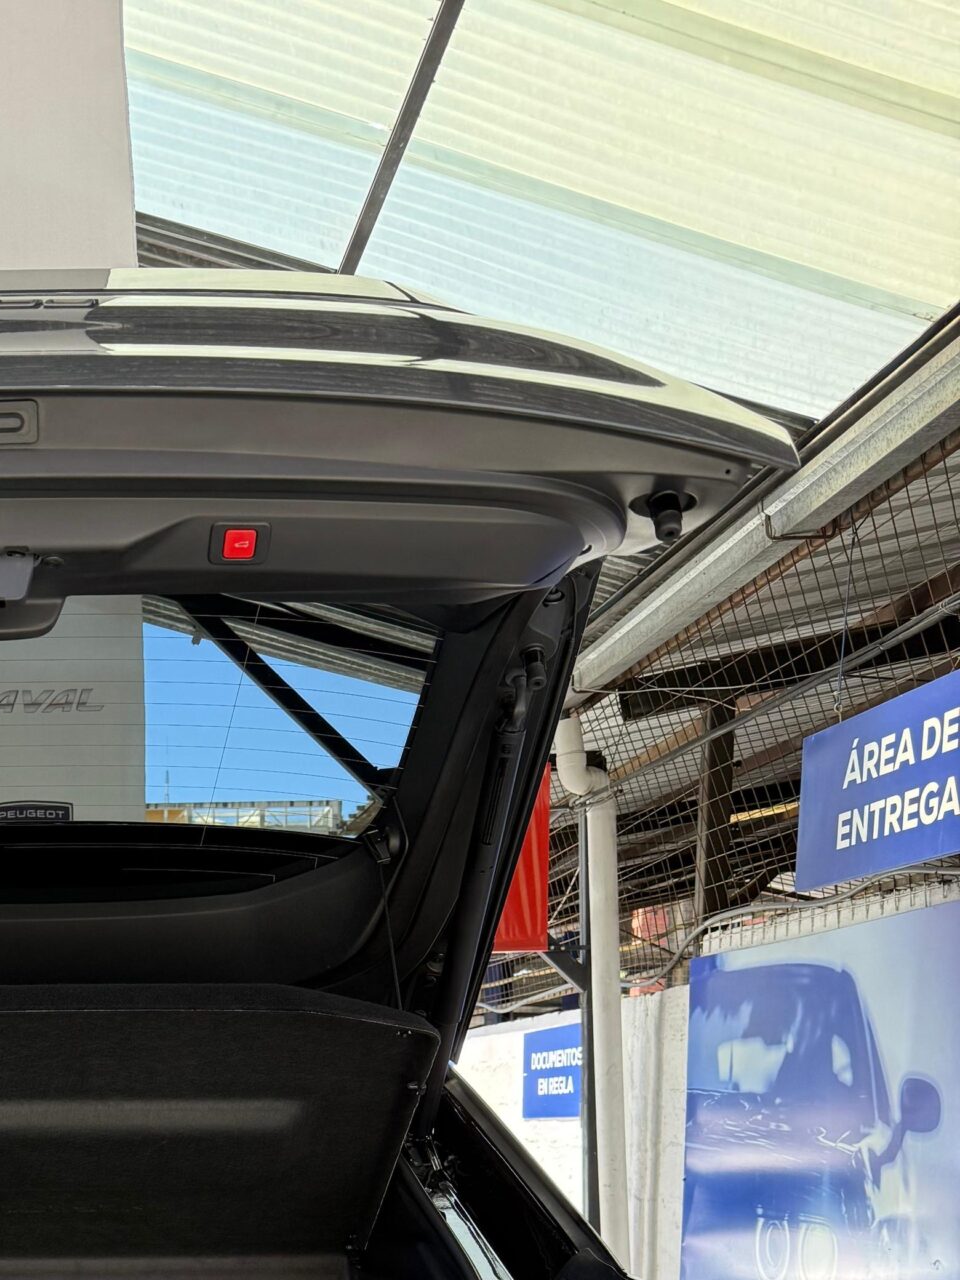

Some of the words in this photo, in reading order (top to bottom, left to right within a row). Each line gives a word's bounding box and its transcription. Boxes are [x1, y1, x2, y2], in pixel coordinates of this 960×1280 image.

[842, 728, 915, 790] ÁREA
[921, 706, 960, 761] DE
[836, 775, 960, 850] ENTREGA
[531, 1047, 582, 1070] DOCUMENTOS
[537, 1078, 548, 1095] EN
[548, 1075, 574, 1094] REGLA
